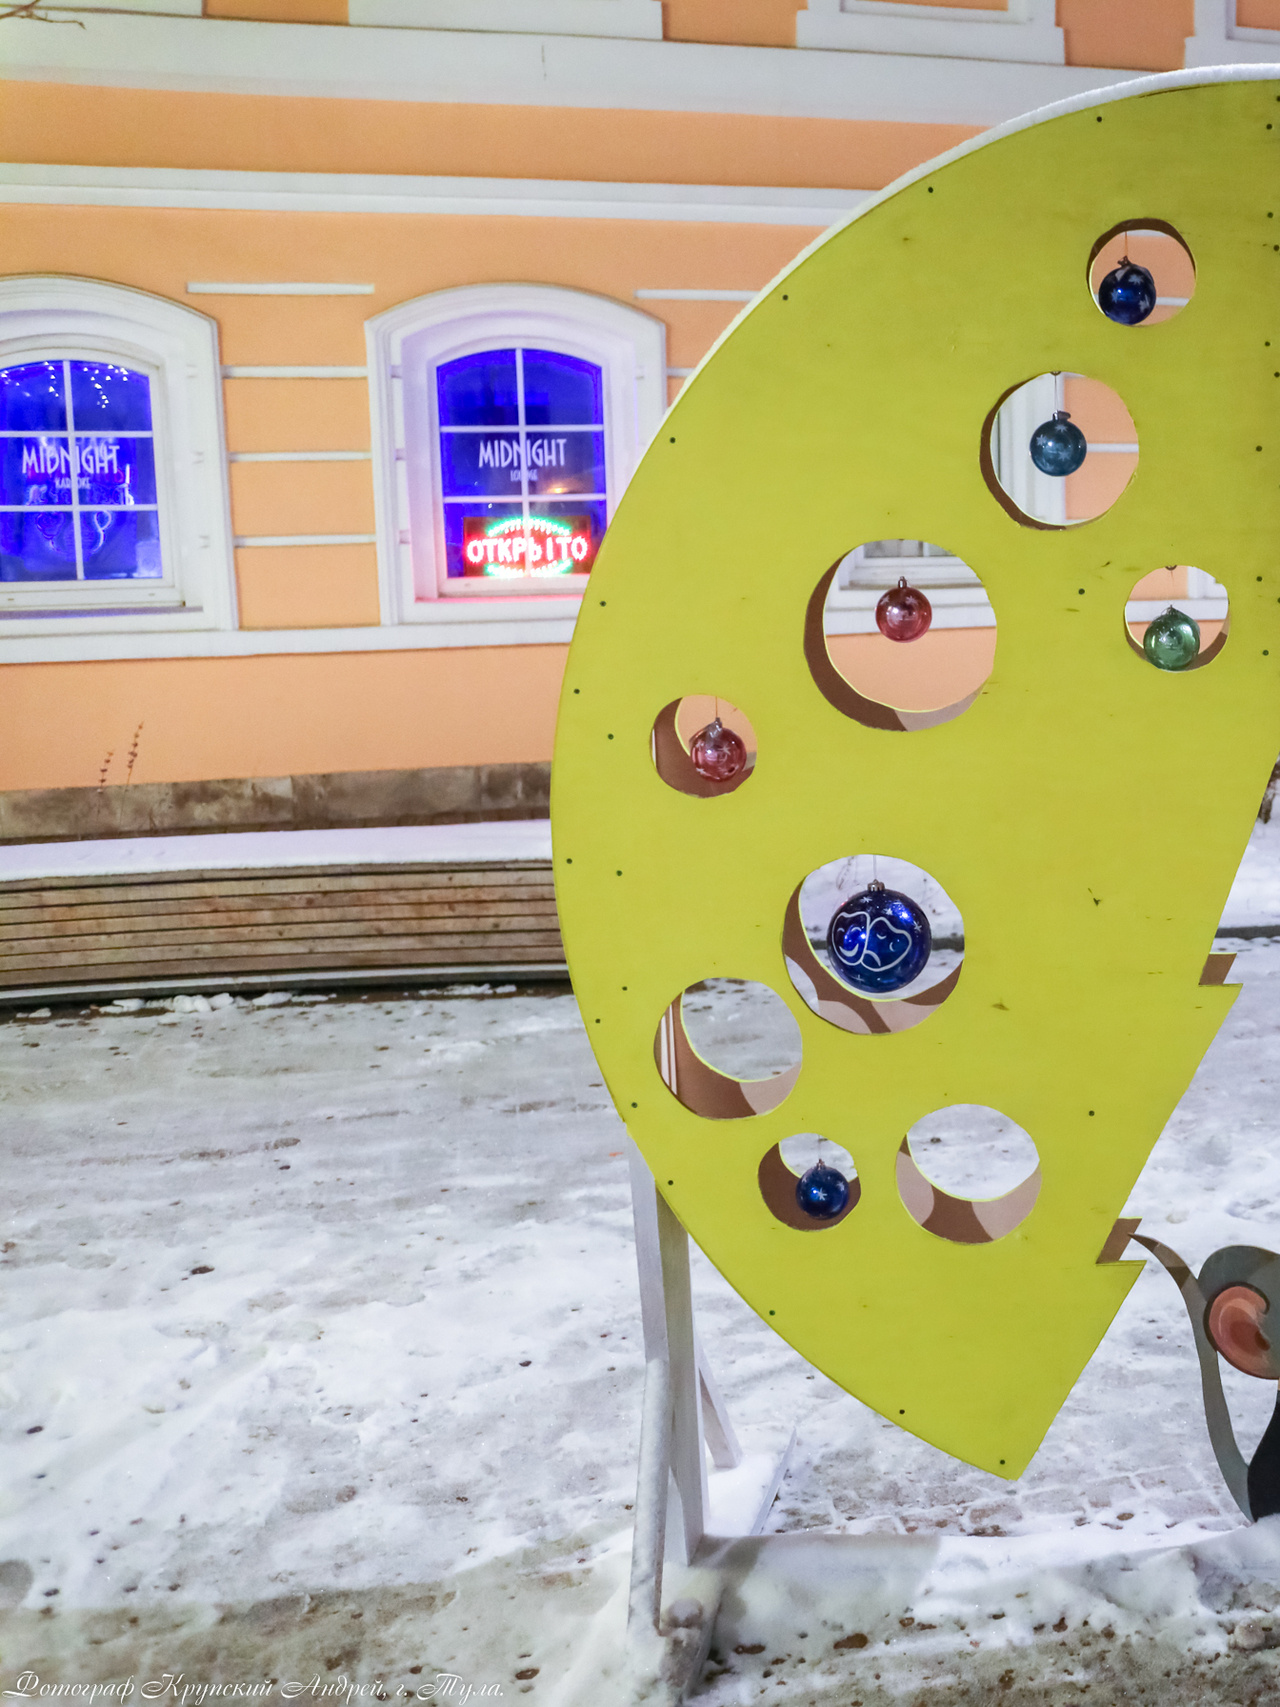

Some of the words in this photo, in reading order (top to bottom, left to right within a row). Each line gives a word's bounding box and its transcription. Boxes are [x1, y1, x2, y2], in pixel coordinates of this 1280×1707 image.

[22, 444, 120, 474] MIDNIGHT
[478, 438, 567, 468] MIDNIGHT
[55, 477, 91, 489] KAROKE
[466, 536, 588, 563] ОТКРЫТО
